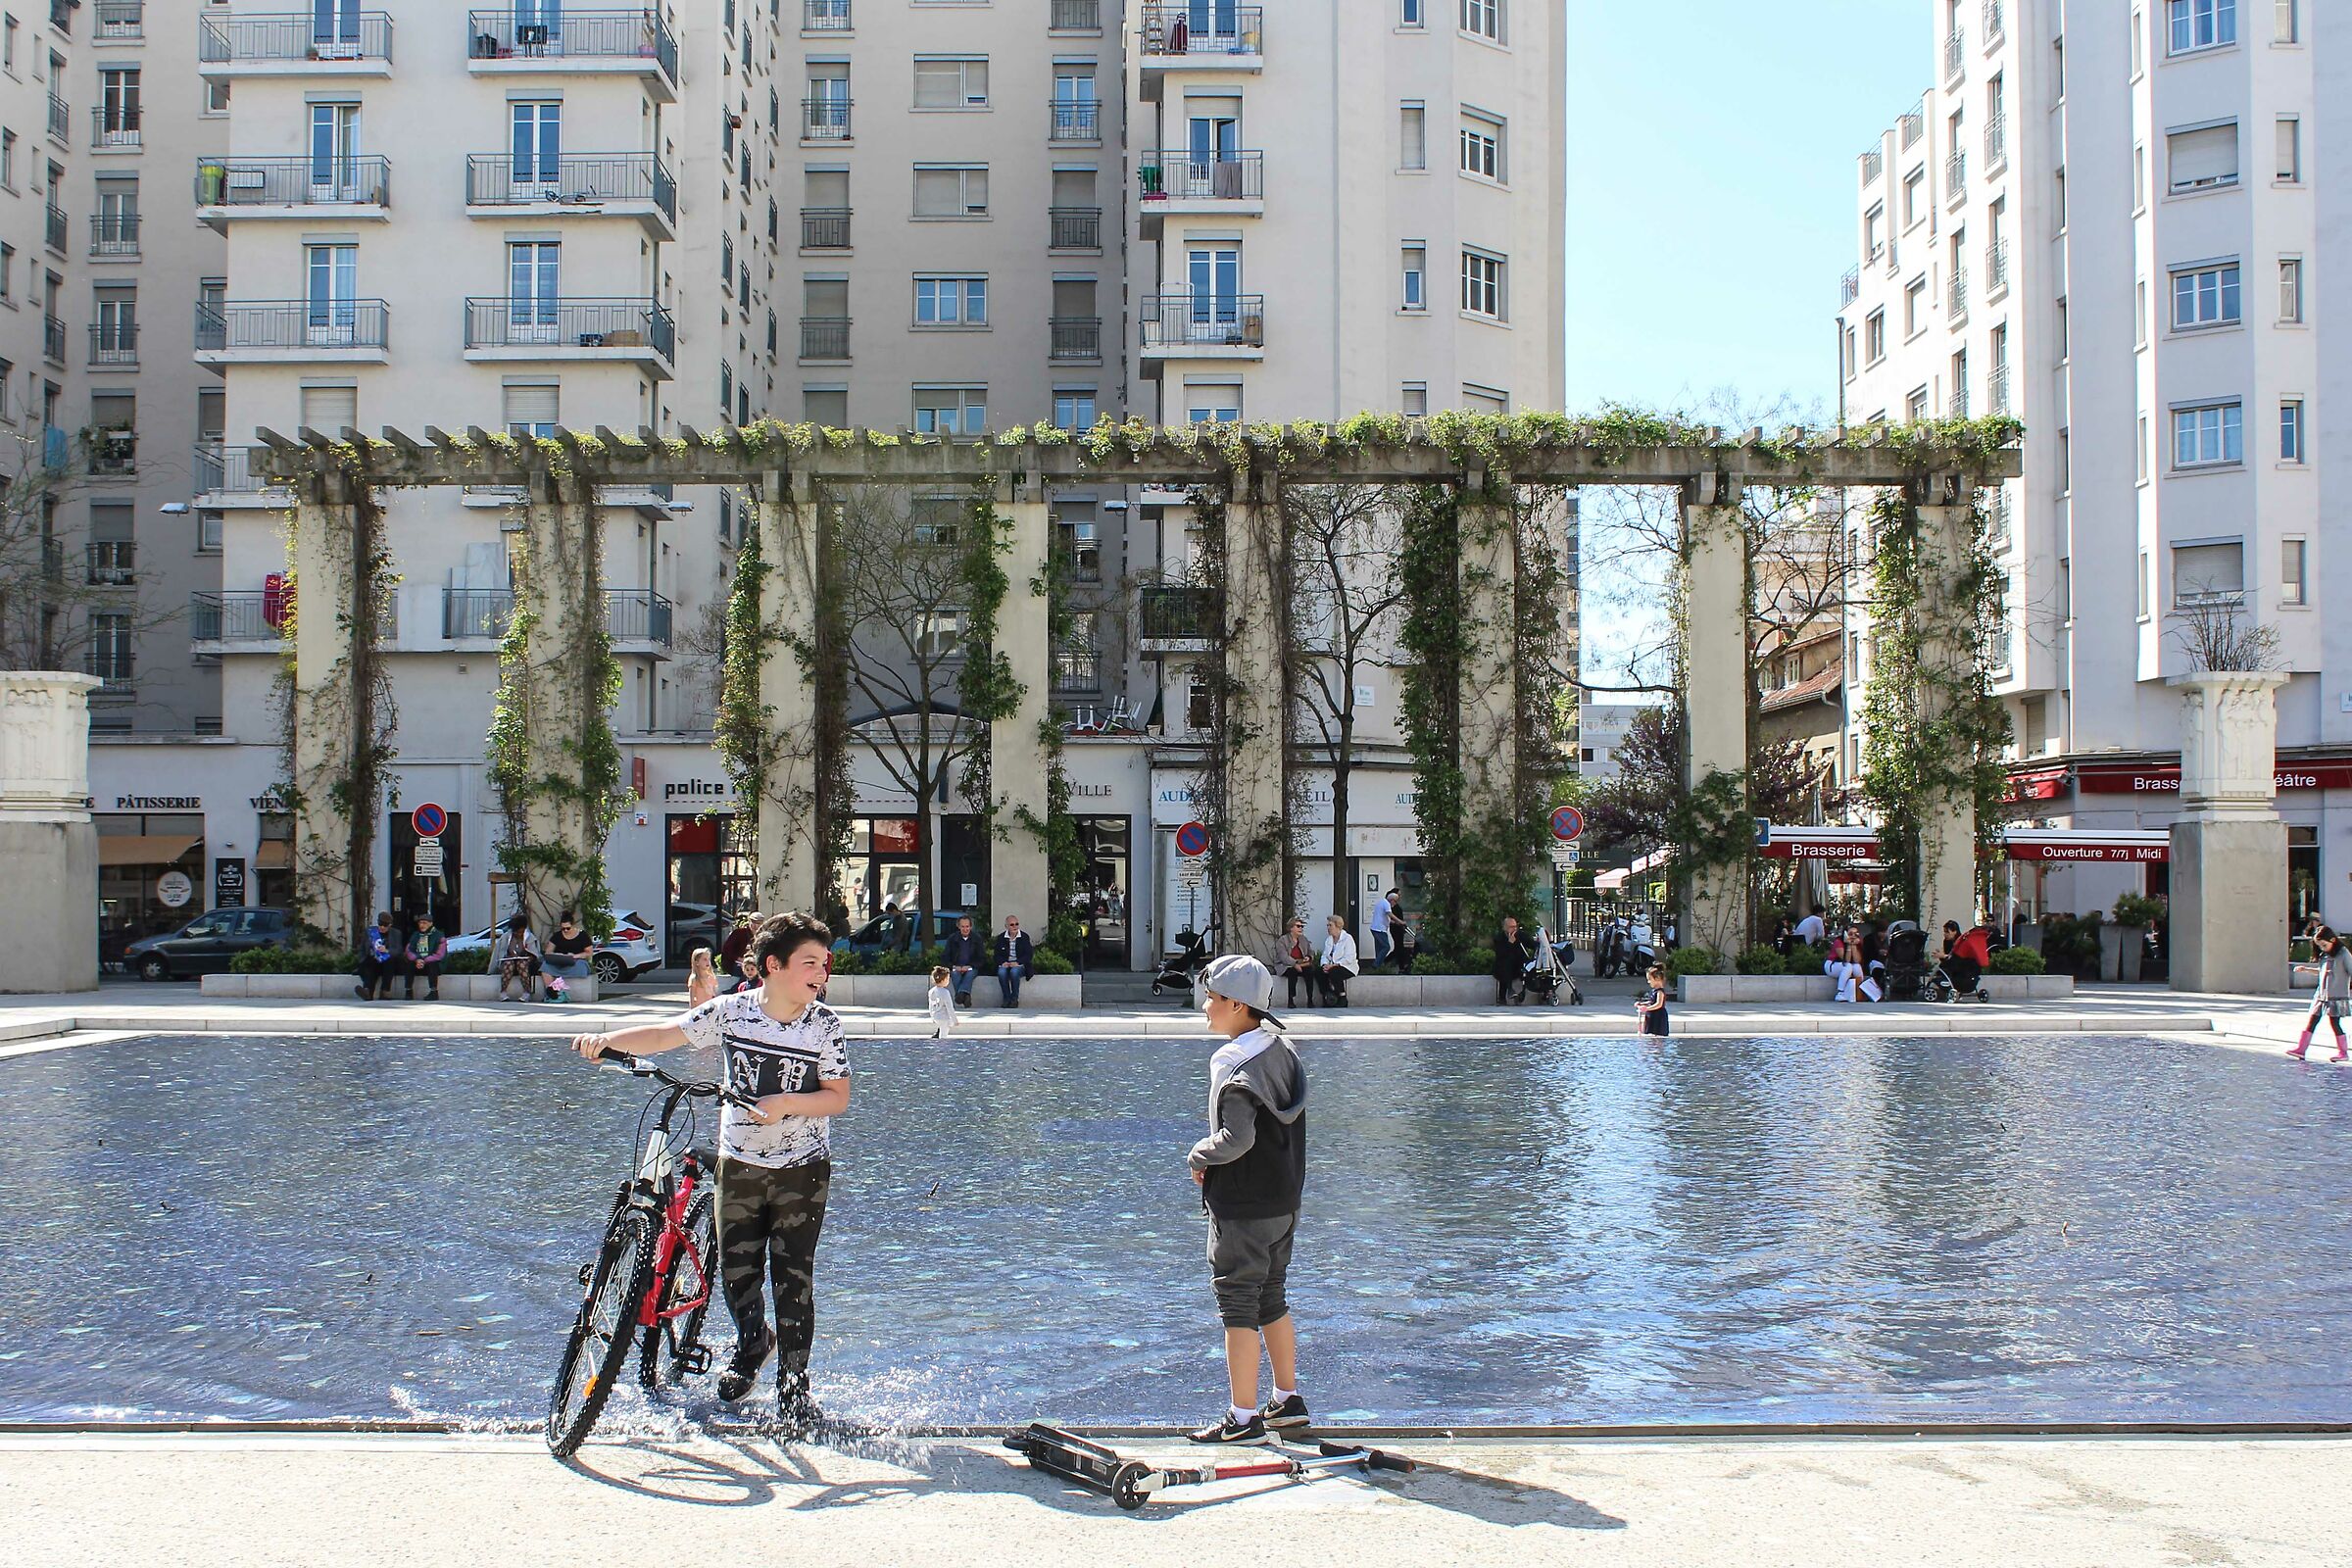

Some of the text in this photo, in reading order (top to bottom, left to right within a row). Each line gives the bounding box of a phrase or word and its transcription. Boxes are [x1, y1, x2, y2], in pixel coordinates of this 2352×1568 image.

[2134, 777, 2180, 790] Brass
[2275, 773, 2317, 787] éâtre
[664, 778, 724, 800] police
[116, 794, 202, 808] PÂTISSERIE
[1304, 791, 1331, 802] EIL
[1396, 793, 1417, 805] AUD
[1791, 844, 1866, 857] Brasserie
[2042, 846, 2162, 860] Ouverture 7/7j Midi
